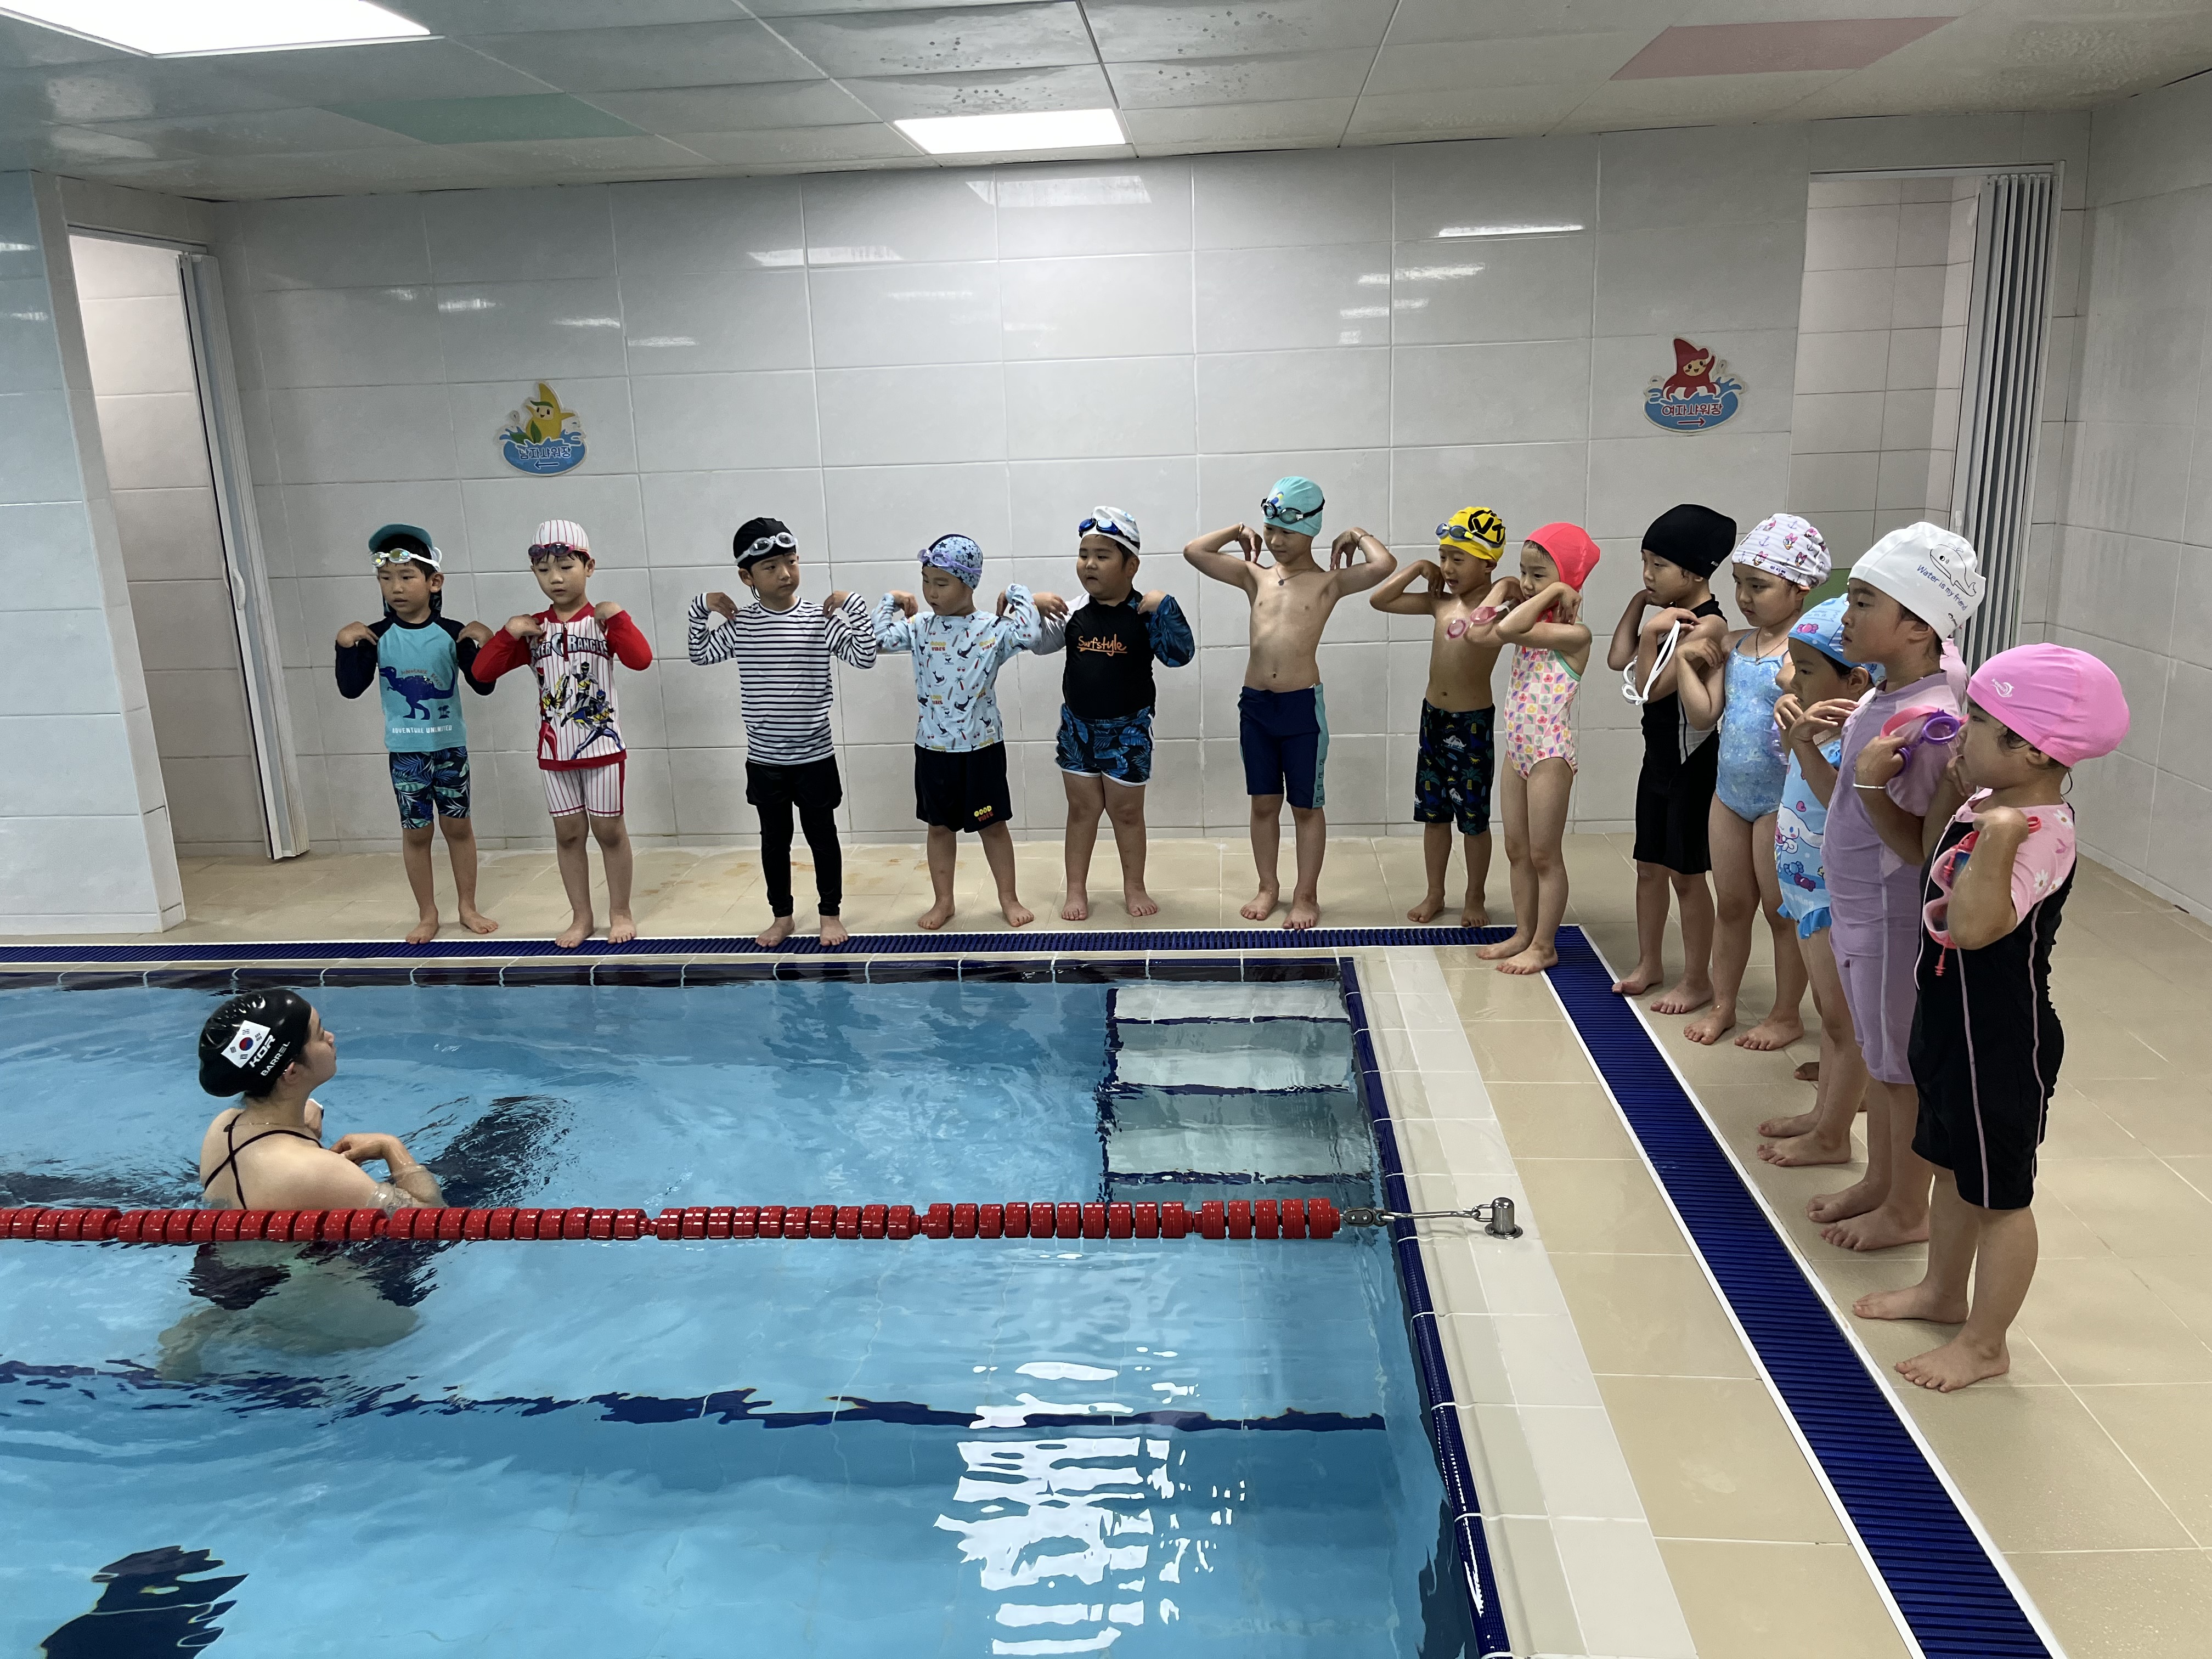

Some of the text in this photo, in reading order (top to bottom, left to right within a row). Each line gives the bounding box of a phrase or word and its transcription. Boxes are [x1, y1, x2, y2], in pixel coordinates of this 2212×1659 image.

[1662, 403, 1723, 416] 여자샤워장
[519, 446, 571, 459] 남자샤워장
[1917, 565, 1968, 611] Water is my friend
[1077, 633, 1127, 657] Surfstyle
[249, 1034, 275, 1068] KOR
[260, 1041, 291, 1076] BARREL
